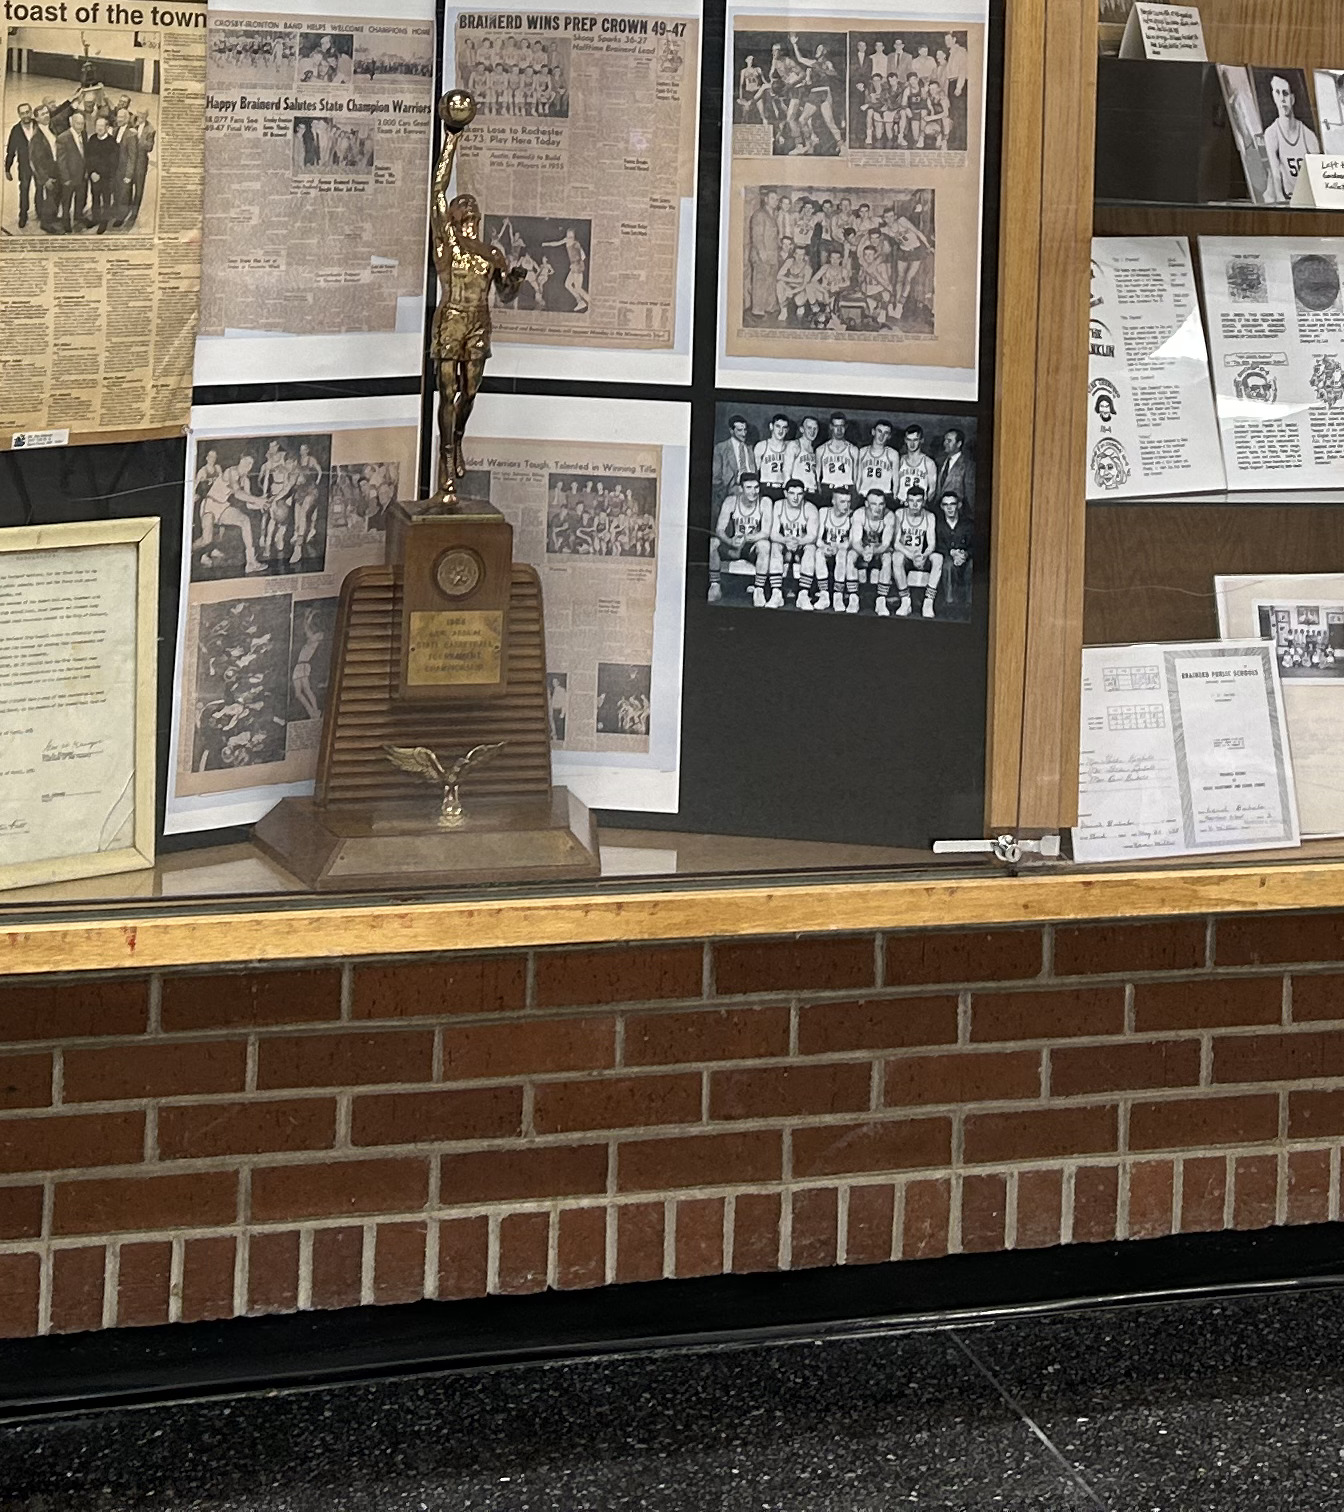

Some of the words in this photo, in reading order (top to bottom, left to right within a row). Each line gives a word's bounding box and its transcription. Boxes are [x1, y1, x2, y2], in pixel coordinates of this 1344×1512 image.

[3, 0, 68, 23] toast
[74, 2, 100, 23] of
[106, 4, 144, 25] the
[150, 6, 207, 29] town
[283, 22, 303, 30] BAND
[306, 23, 326, 31] HELPS
[330, 24, 364, 33] WELCOME
[368, 26, 408, 35] CHAMPIONS
[411, 27, 431, 36] HOME
[459, 14, 522, 30] BRAINERD
[526, 15, 560, 31] WINS
[564, 16, 598, 34] PREP
[601, 17, 649, 35] CROWN
[651, 20, 687, 37] 49-47
[624, 36, 648, 44] 36-27
[572, 43, 604, 51] Halftime
[605, 44, 636, 53] Brainerd
[638, 46, 656, 54] Lead
[206, 95, 237, 112] Happy
[239, 96, 281, 111] Brainerd
[283, 96, 317, 111] Salutes
[319, 98, 344, 112] State
[346, 98, 390, 115] Champion
[392, 99, 431, 114] Warriors
[487, 126, 506, 134] Lose
[521, 126, 563, 136] Rochester
[490, 135, 508, 144] Play
[511, 135, 532, 144] Here
[534, 136, 561, 147] Today
[487, 458, 522, 468] Warriors
[523, 459, 552, 470] Tough,
[554, 460, 590, 471] Talented
[602, 462, 636, 474] Winning
[638, 464, 657, 474] Title
[828, 462, 847, 474] 24
[866, 467, 883, 478] 26
[904, 476, 921, 486] 22
[905, 536, 922, 547] 23
[1181, 670, 1210, 679] BRAINERD
[1211, 670, 1233, 678] PUBLIC
[1233, 669, 1259, 677] SCHOOLS
